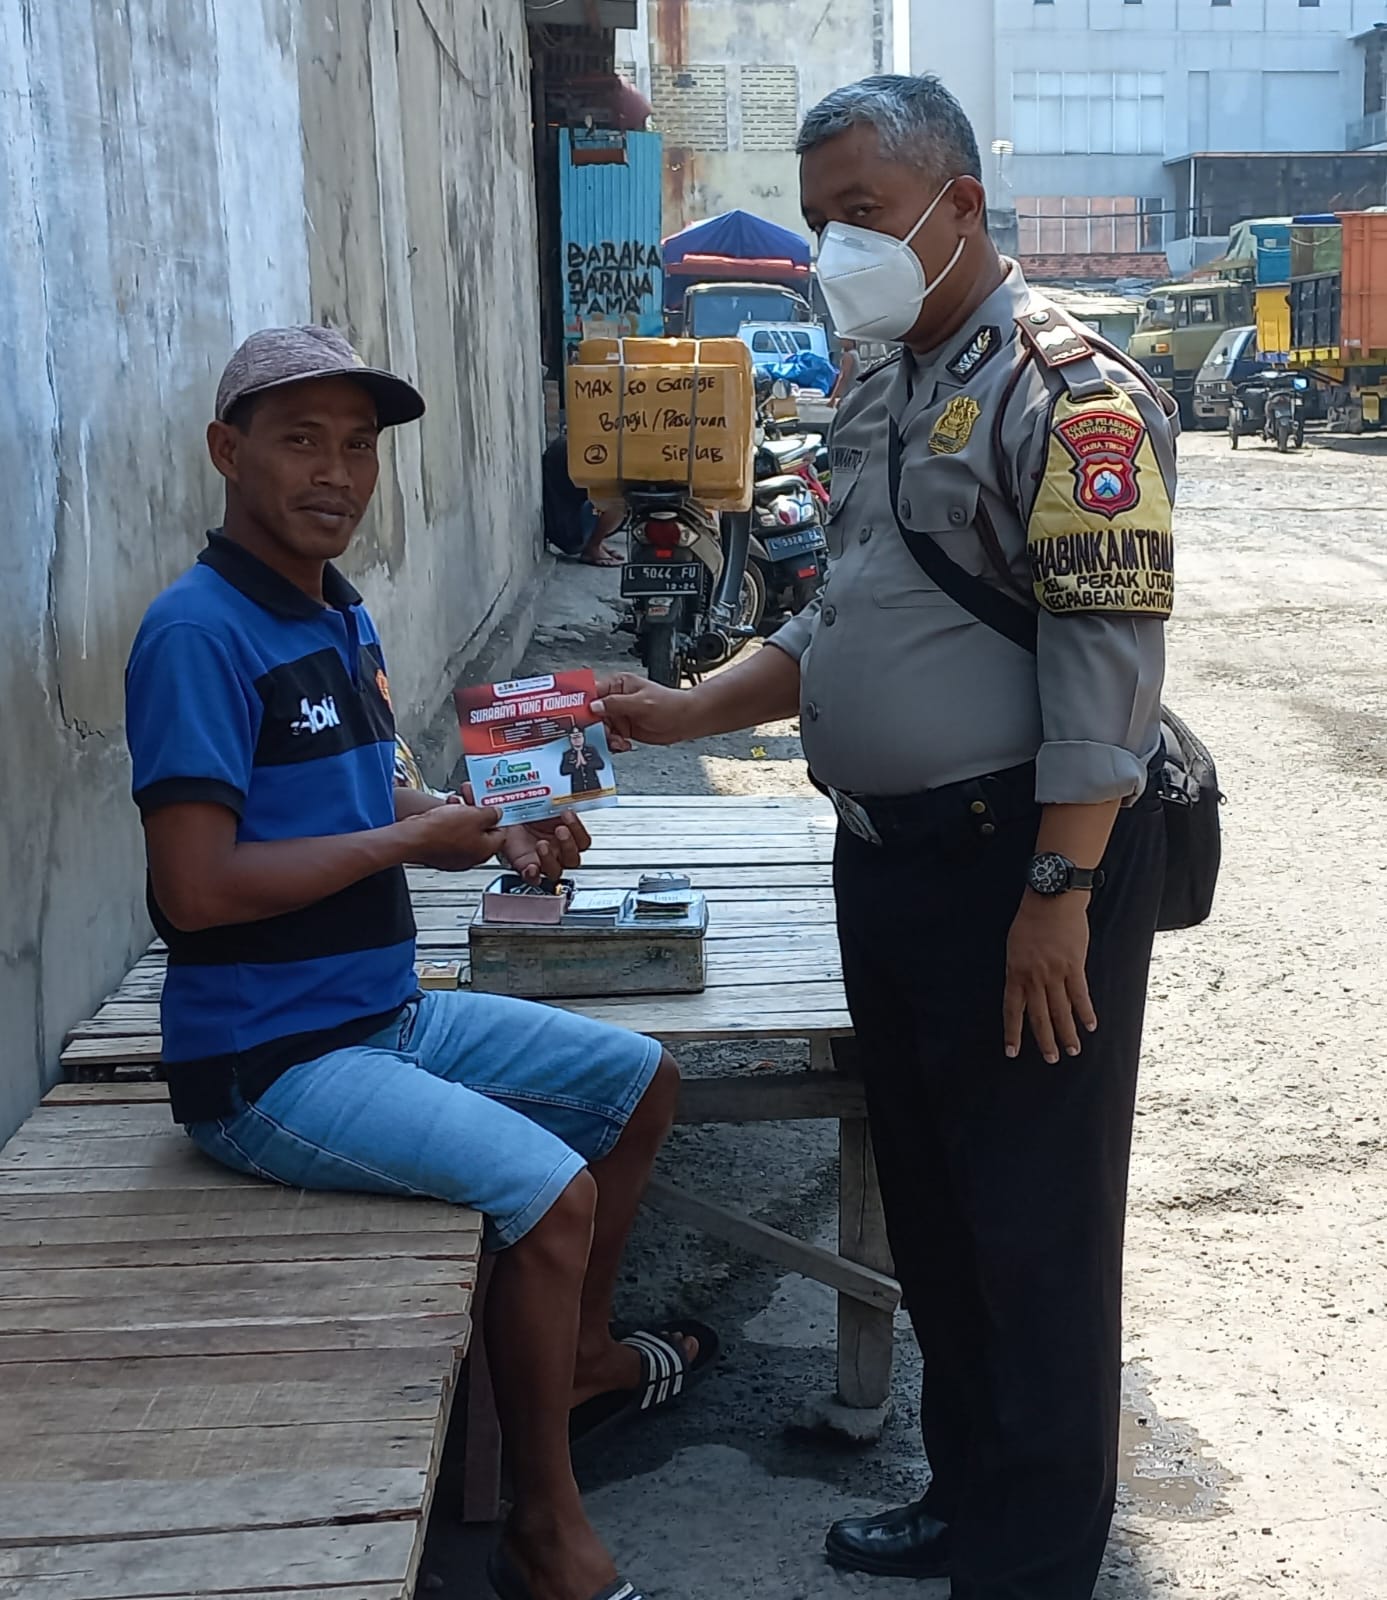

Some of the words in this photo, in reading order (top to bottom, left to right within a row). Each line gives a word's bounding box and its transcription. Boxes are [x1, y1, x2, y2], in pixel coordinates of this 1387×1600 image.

[568, 240, 661, 269] BARAKA
[569, 295, 641, 314] TAMA
[575, 379, 613, 399] MAX
[622, 380, 646, 397] EO
[628, 567, 635, 580] L
[642, 567, 672, 580] 5044
[681, 566, 696, 579] FU
[1077, 571, 1139, 589] PERAK
[470, 704, 517, 724] SURABAYA
[517, 700, 541, 715] YANG
[485, 771, 540, 788] KANDANI
